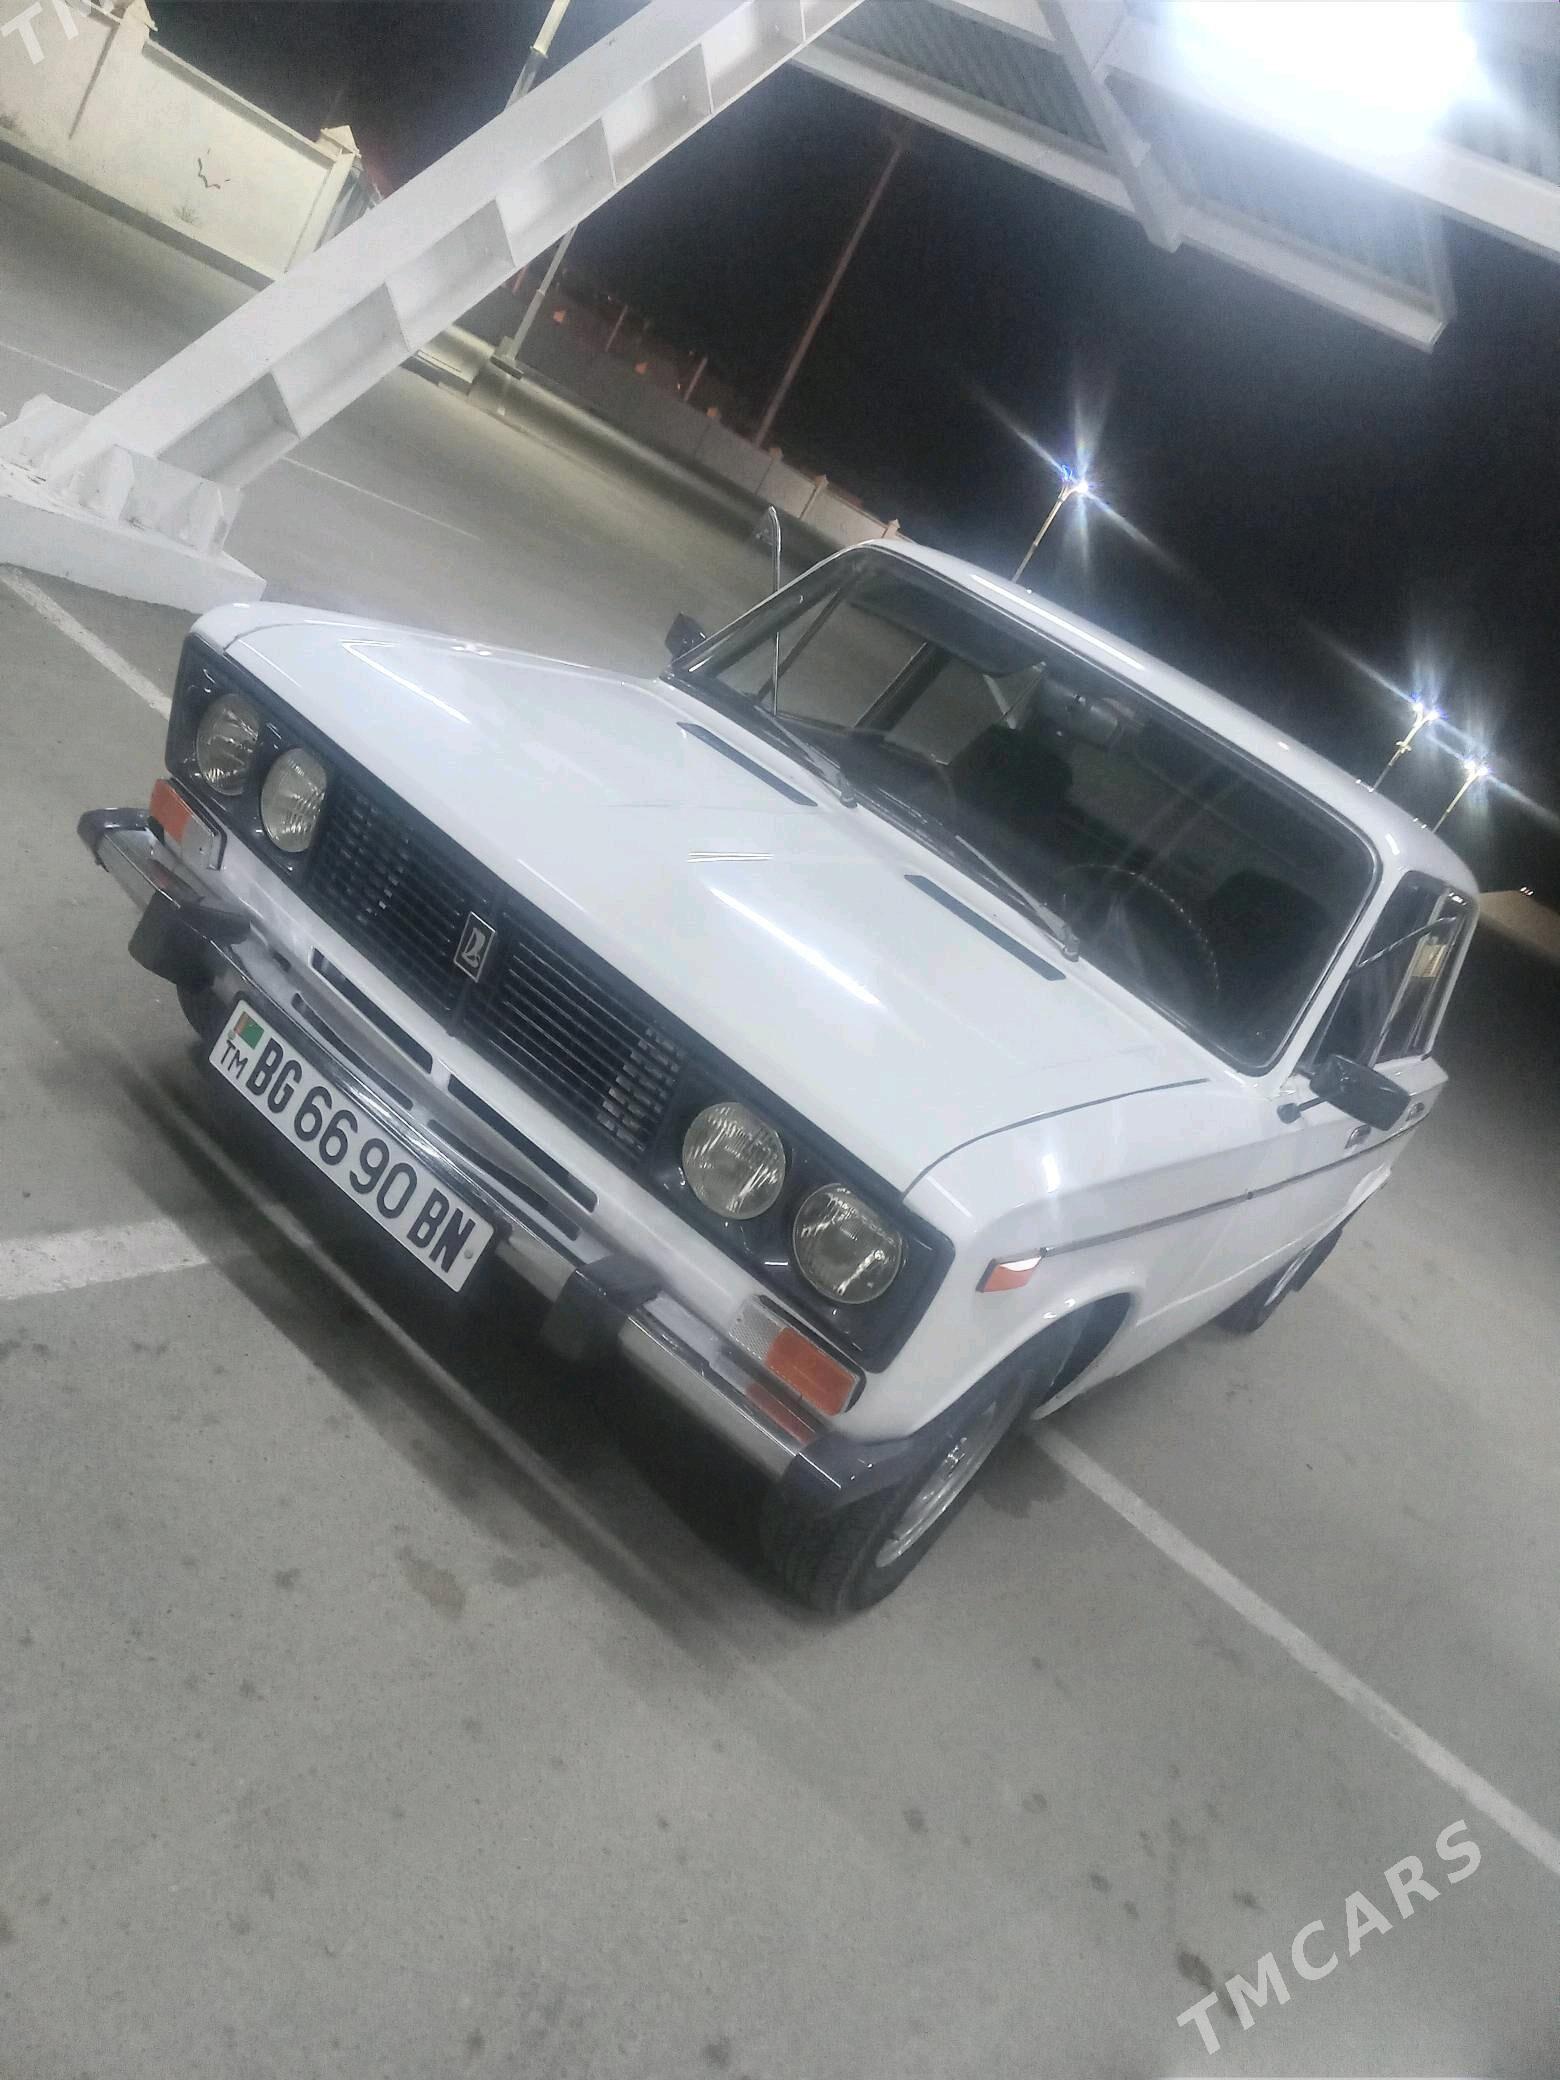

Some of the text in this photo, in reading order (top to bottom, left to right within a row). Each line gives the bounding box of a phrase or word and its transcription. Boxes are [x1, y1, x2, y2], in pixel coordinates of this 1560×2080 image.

[220, 1040, 248, 1080] TM
[245, 1037, 303, 1114] BG
[406, 1187, 477, 1274] BN
